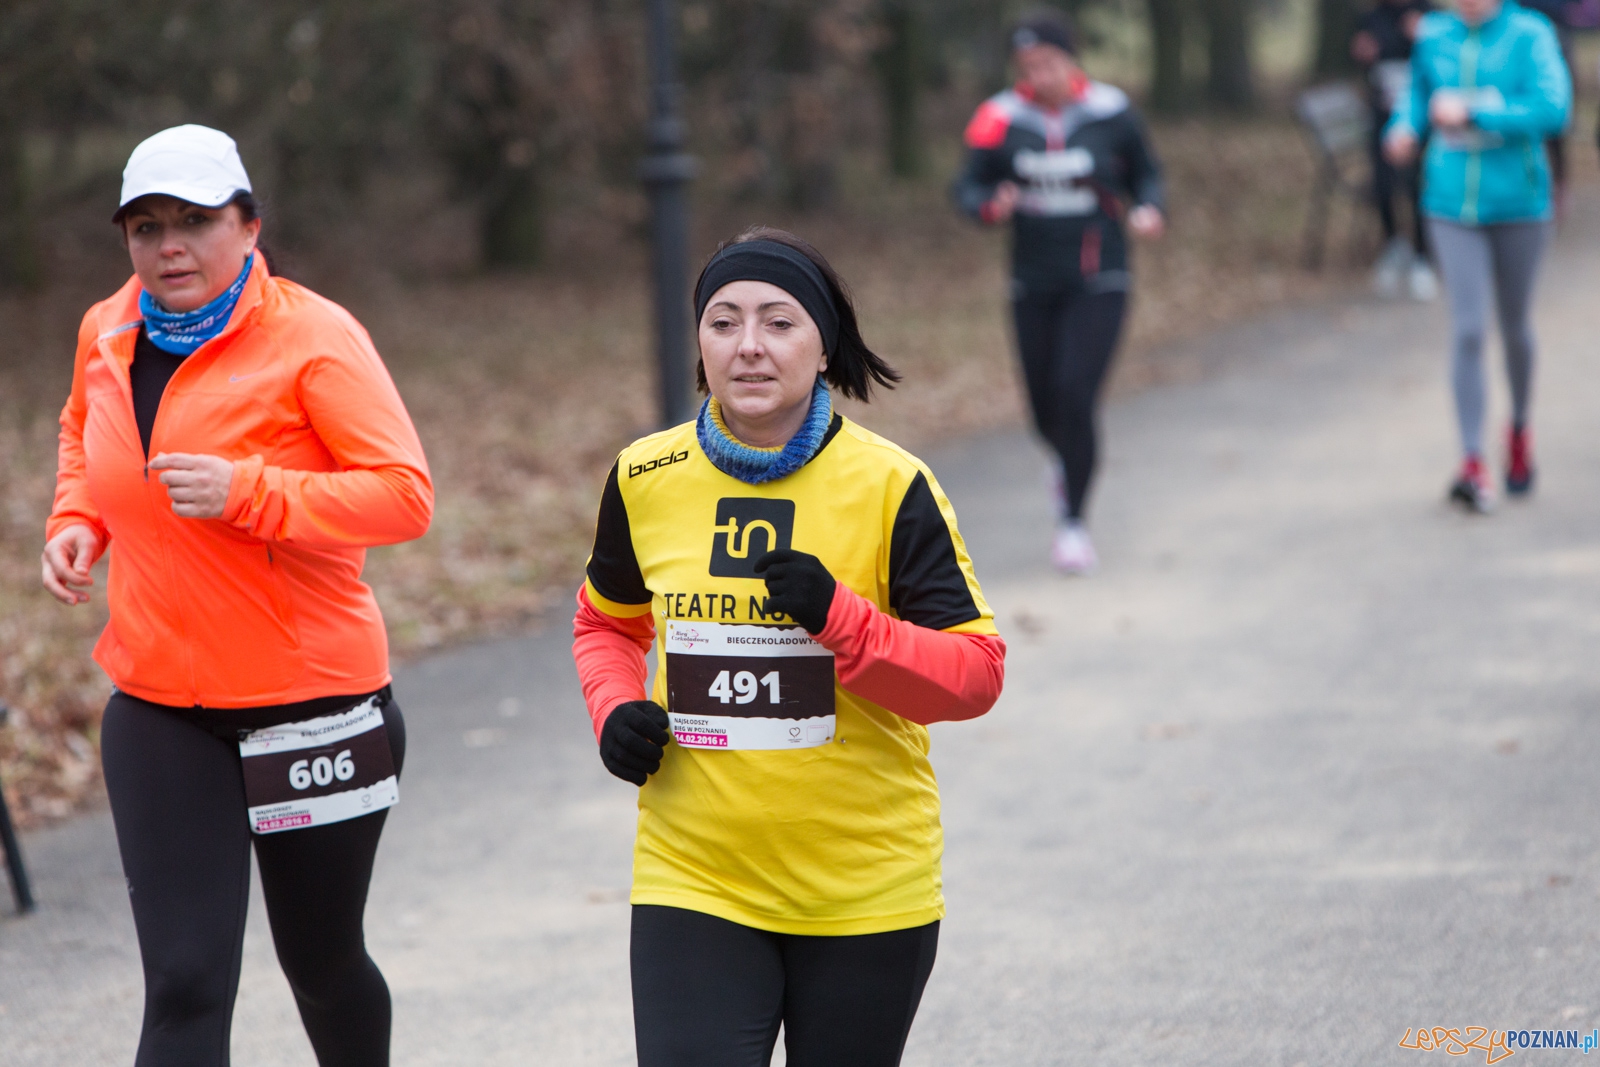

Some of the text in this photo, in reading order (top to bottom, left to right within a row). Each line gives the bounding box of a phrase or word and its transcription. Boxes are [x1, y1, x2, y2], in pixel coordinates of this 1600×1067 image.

[664, 593, 736, 619] TEATR
[727, 636, 819, 645] BIEGCZEKOLADOWY.
[708, 670, 781, 704] 491
[675, 733, 718, 745] 14.02.2016
[289, 749, 355, 790] 606
